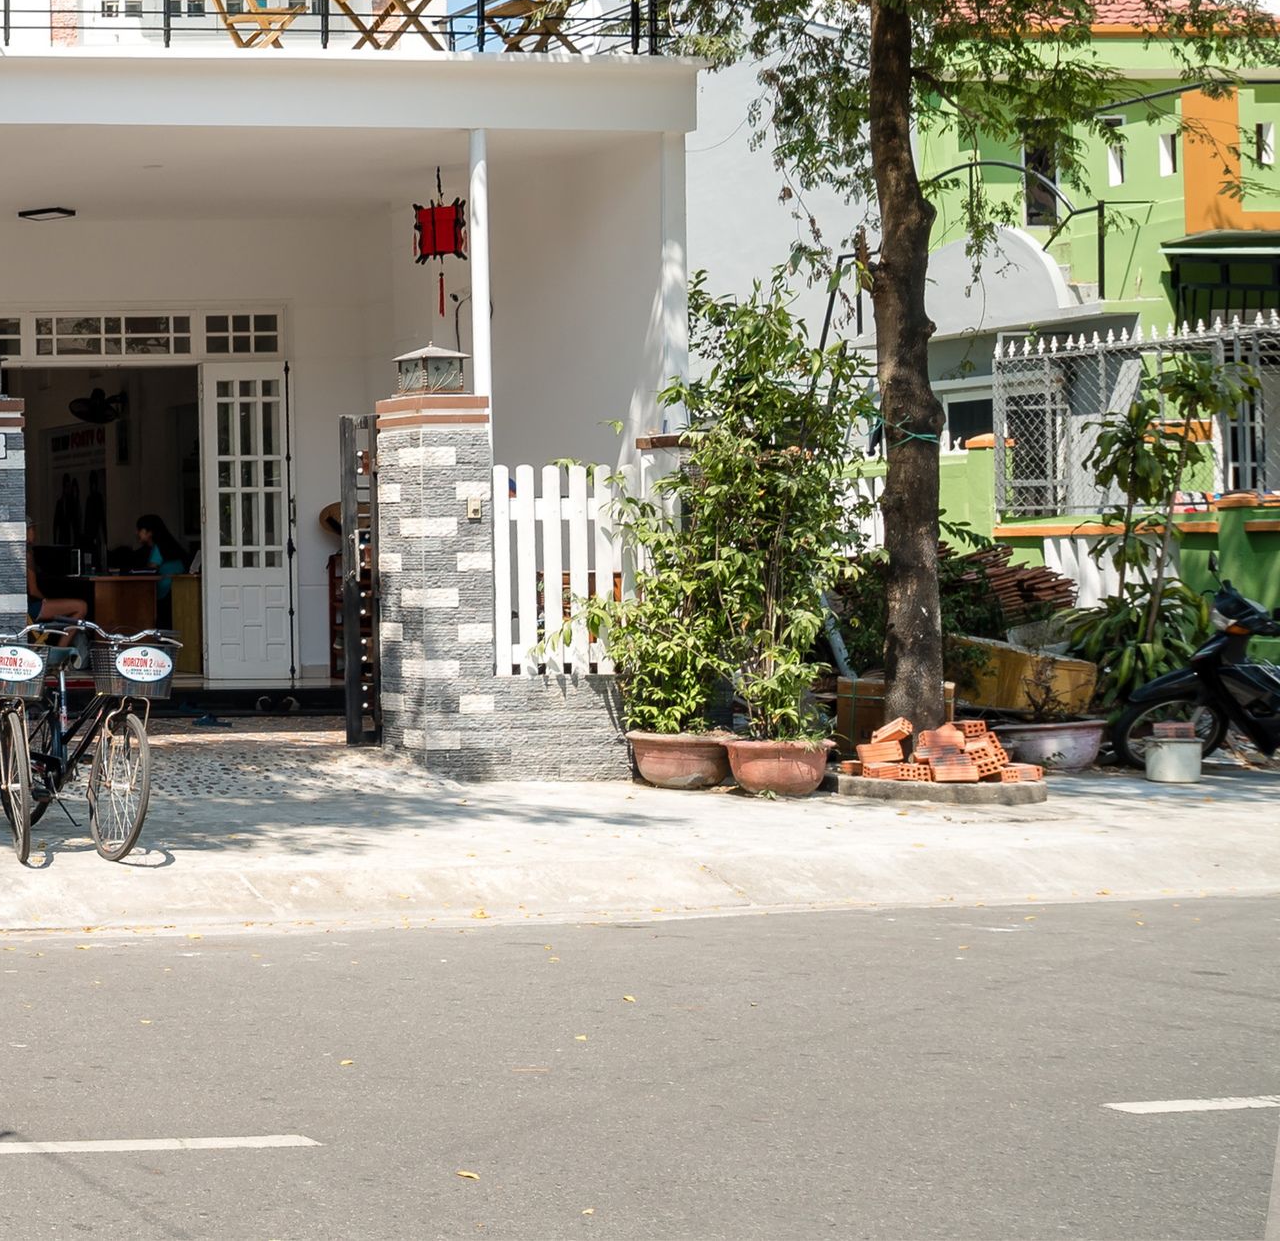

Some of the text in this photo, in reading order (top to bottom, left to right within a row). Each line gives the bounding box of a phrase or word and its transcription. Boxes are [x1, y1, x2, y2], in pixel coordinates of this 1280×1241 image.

[18, 658, 23, 668] 2
[122, 657, 148, 668] HORIZON
[149, 658, 153, 668] 2
